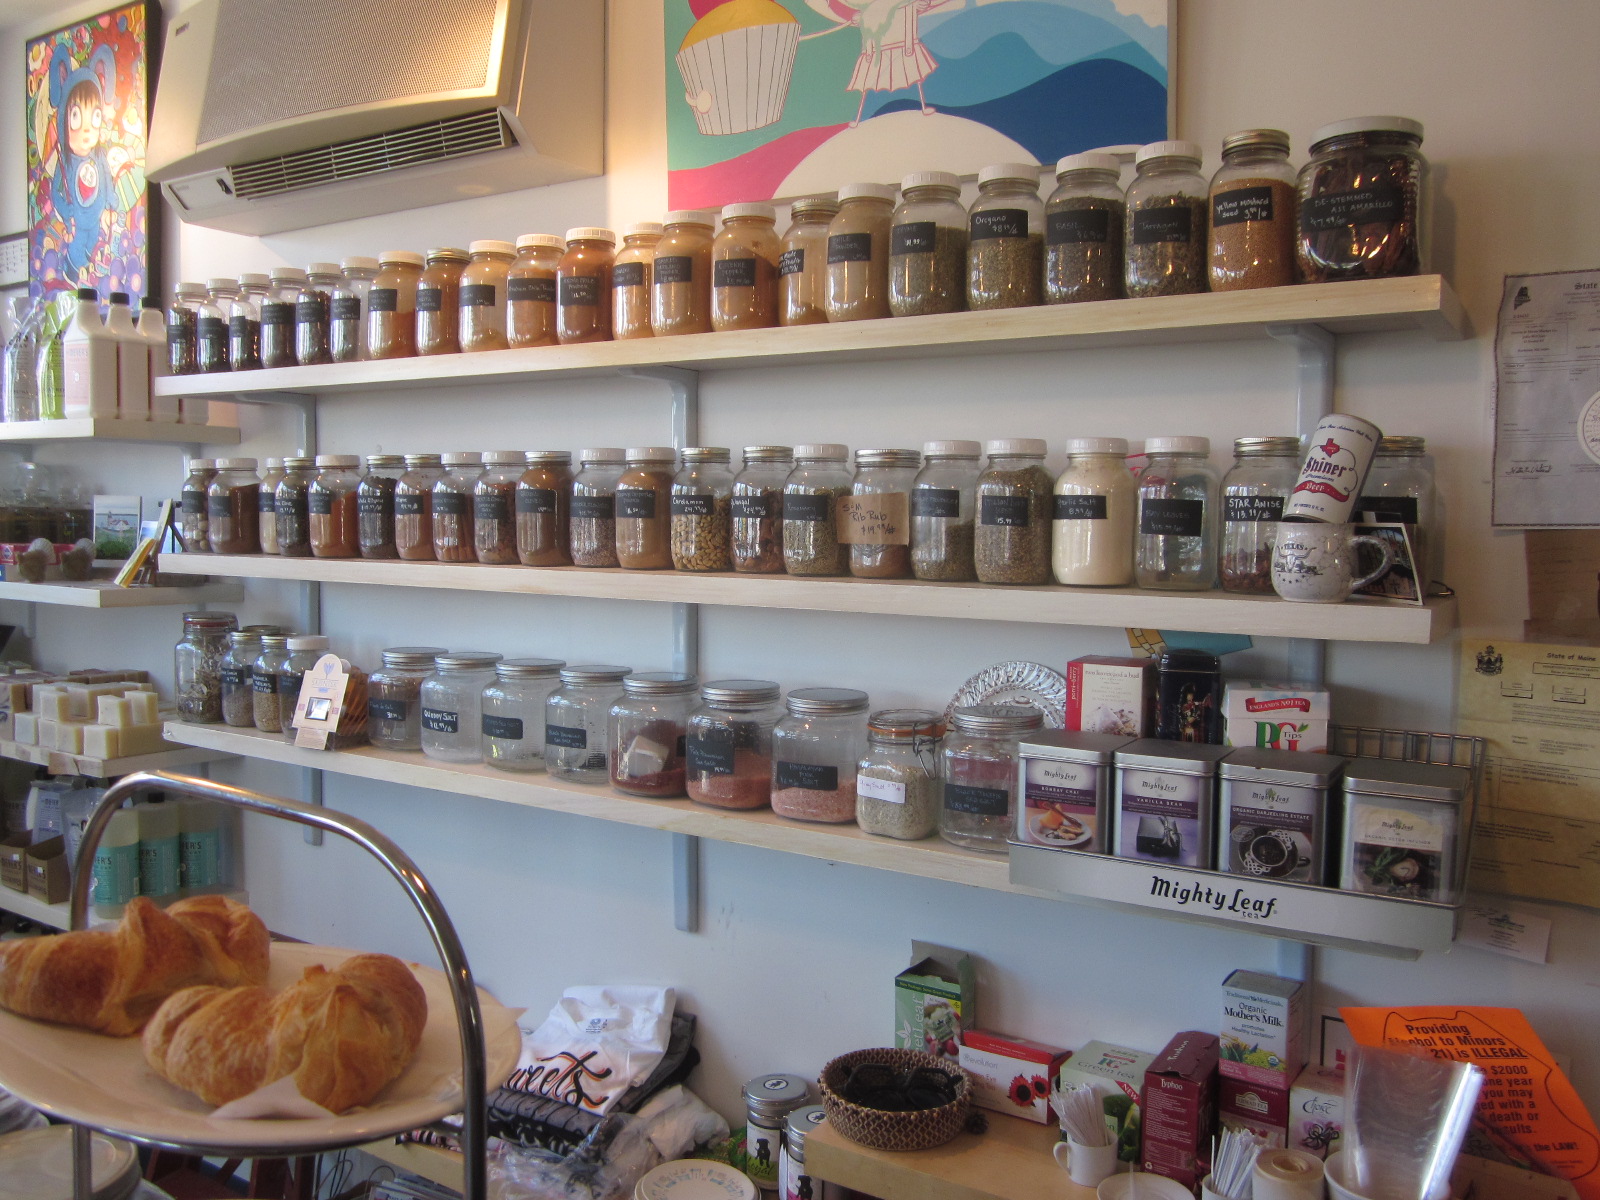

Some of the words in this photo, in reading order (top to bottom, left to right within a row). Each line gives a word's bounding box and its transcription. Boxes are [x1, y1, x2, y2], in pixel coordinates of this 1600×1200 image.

[975, 214, 1007, 226] Oregano
[1302, 456, 1348, 478] Shiner
[1305, 482, 1325, 491] Beer
[1228, 499, 1250, 508] STAR
[1254, 499, 1282, 508] ANISE
[849, 510, 866, 521] Rib
[866, 510, 887, 521] Rub
[1283, 543, 1305, 551] TEXAS
[1546, 652, 1564, 660] State
[1249, 701, 1281, 710] ENGLAND'S
[1254, 720, 1301, 752] PG
[1284, 730, 1303, 740] Tips
[1043, 769, 1065, 780] Mighty
[1064, 772, 1078, 781] Leaf
[1142, 780, 1164, 791] Mighty
[1163, 783, 1178, 793] Leaf
[1136, 797, 1164, 805] VANILLA
[1251, 791, 1275, 803] Mighty
[1275, 794, 1290, 804] Leaf
[1256, 810, 1289, 818] DARJEELING
[1381, 821, 1401, 830] Mighty
[1400, 823, 1414, 832] Leaf
[1150, 875, 1232, 911] Mighty
[1227, 888, 1283, 919] Leaf
[1242, 910, 1259, 919] tea
[1238, 1001, 1268, 1015] Organic
[1223, 1005, 1261, 1023] Mother's
[1262, 1014, 1283, 1027] Milk
[1231, 1026, 1250, 1035] Healthy
[1241, 1023, 1265, 1032] promotes
[1404, 1023, 1471, 1036] Providing
[1439, 1036, 1455, 1046] to
[1458, 1034, 1507, 1046] Minors
[1456, 1048, 1470, 1058] is
[1471, 1047, 1529, 1059] ILLEGAL
[1078, 1061, 1114, 1074] Green
[1116, 1070, 1136, 1080] tea
[1490, 1065, 1529, 1075] $2000
[1160, 1078, 1184, 1091] Typhoo
[1507, 1078, 1533, 1089] year
[1123, 1083, 1140, 1101] NEW
[1483, 1089, 1504, 1099] you
[1507, 1089, 1534, 1099] may
[1302, 1096, 1338, 1115] Choice
[1498, 1100, 1524, 1110] with
[1528, 1101, 1536, 1109] a
[1489, 1111, 1523, 1121] death
[1527, 1112, 1539, 1121] or
[1533, 1143, 1551, 1152] the
[1551, 1141, 1579, 1150] LAW!
